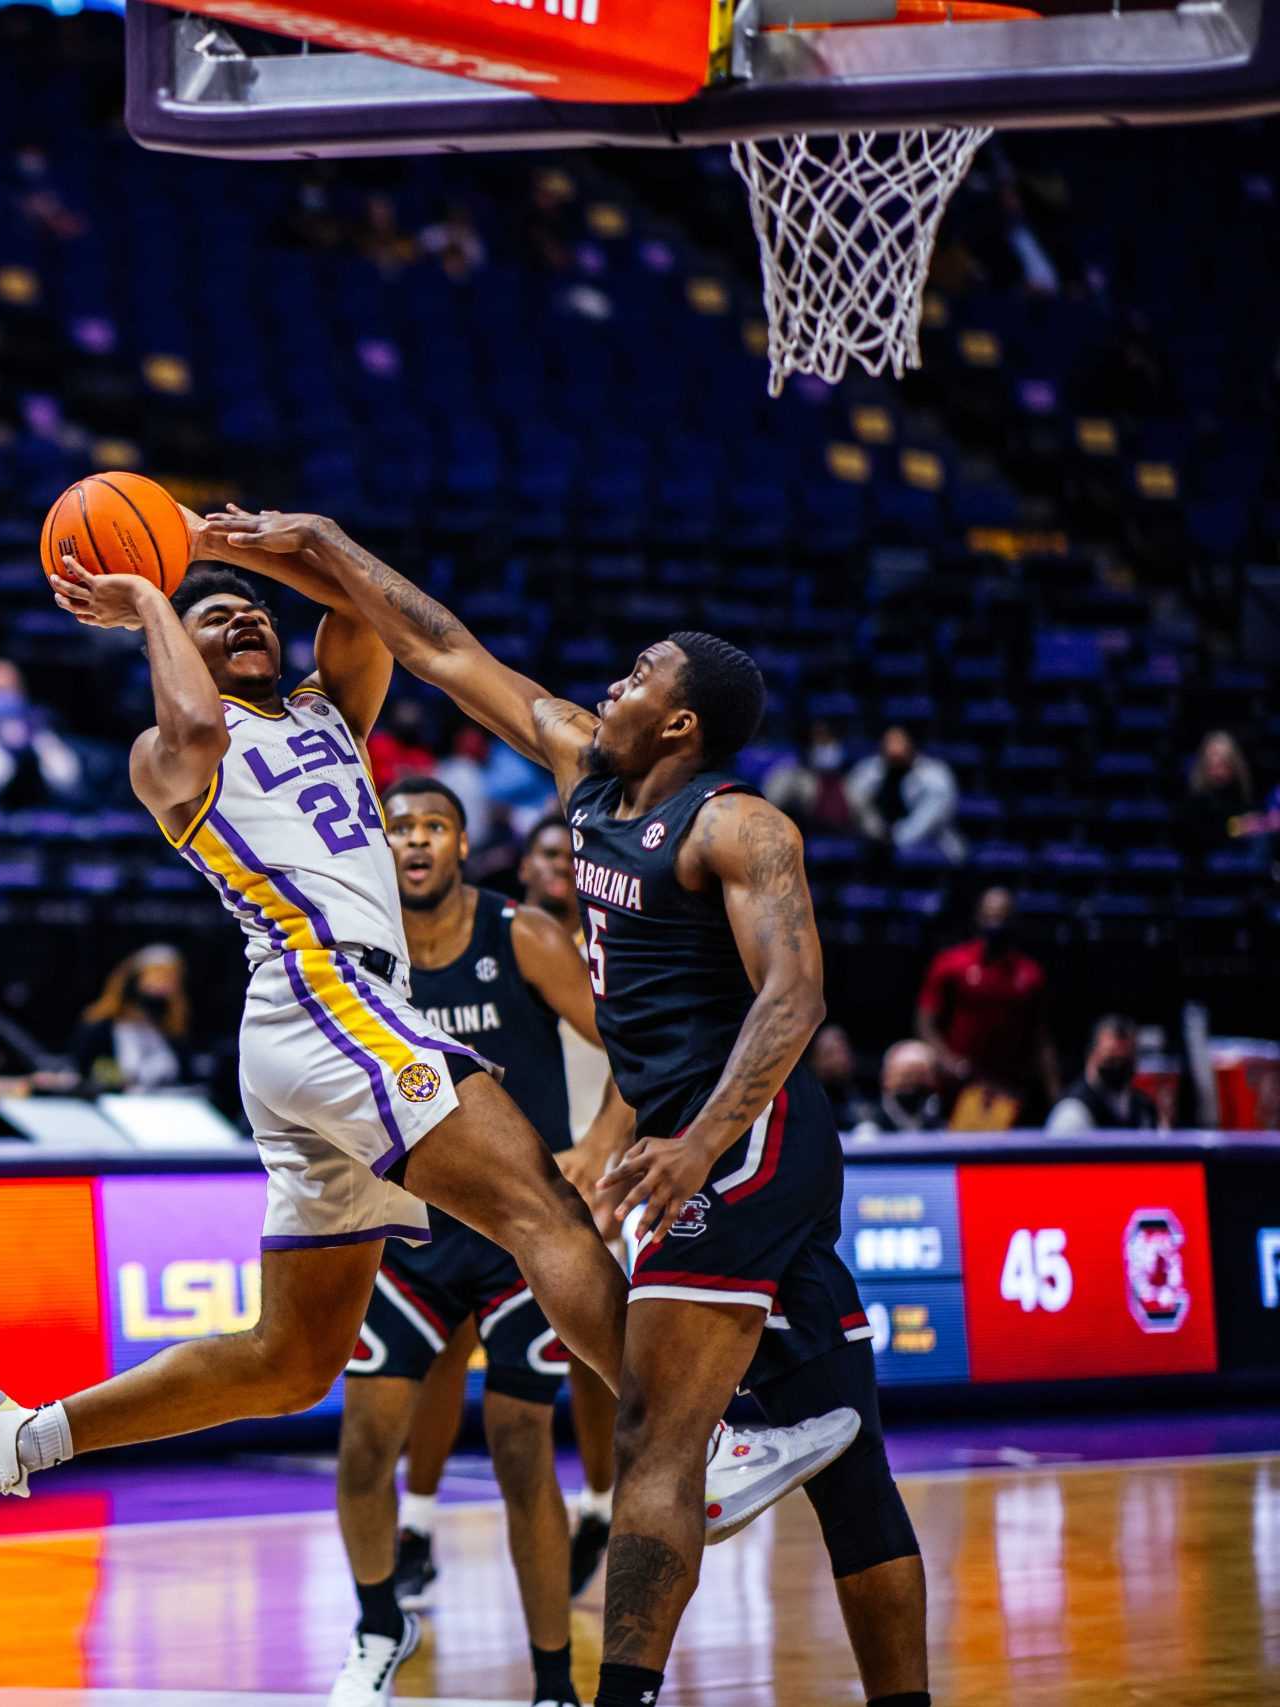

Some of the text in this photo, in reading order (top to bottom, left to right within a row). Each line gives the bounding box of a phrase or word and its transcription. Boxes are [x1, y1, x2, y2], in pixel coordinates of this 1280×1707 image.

[242, 723, 360, 793] LSU
[296, 778, 384, 856] 24
[641, 822, 665, 850] SEC
[119, 1260, 261, 1340] LSU
[1000, 1228, 1073, 1313] 45
